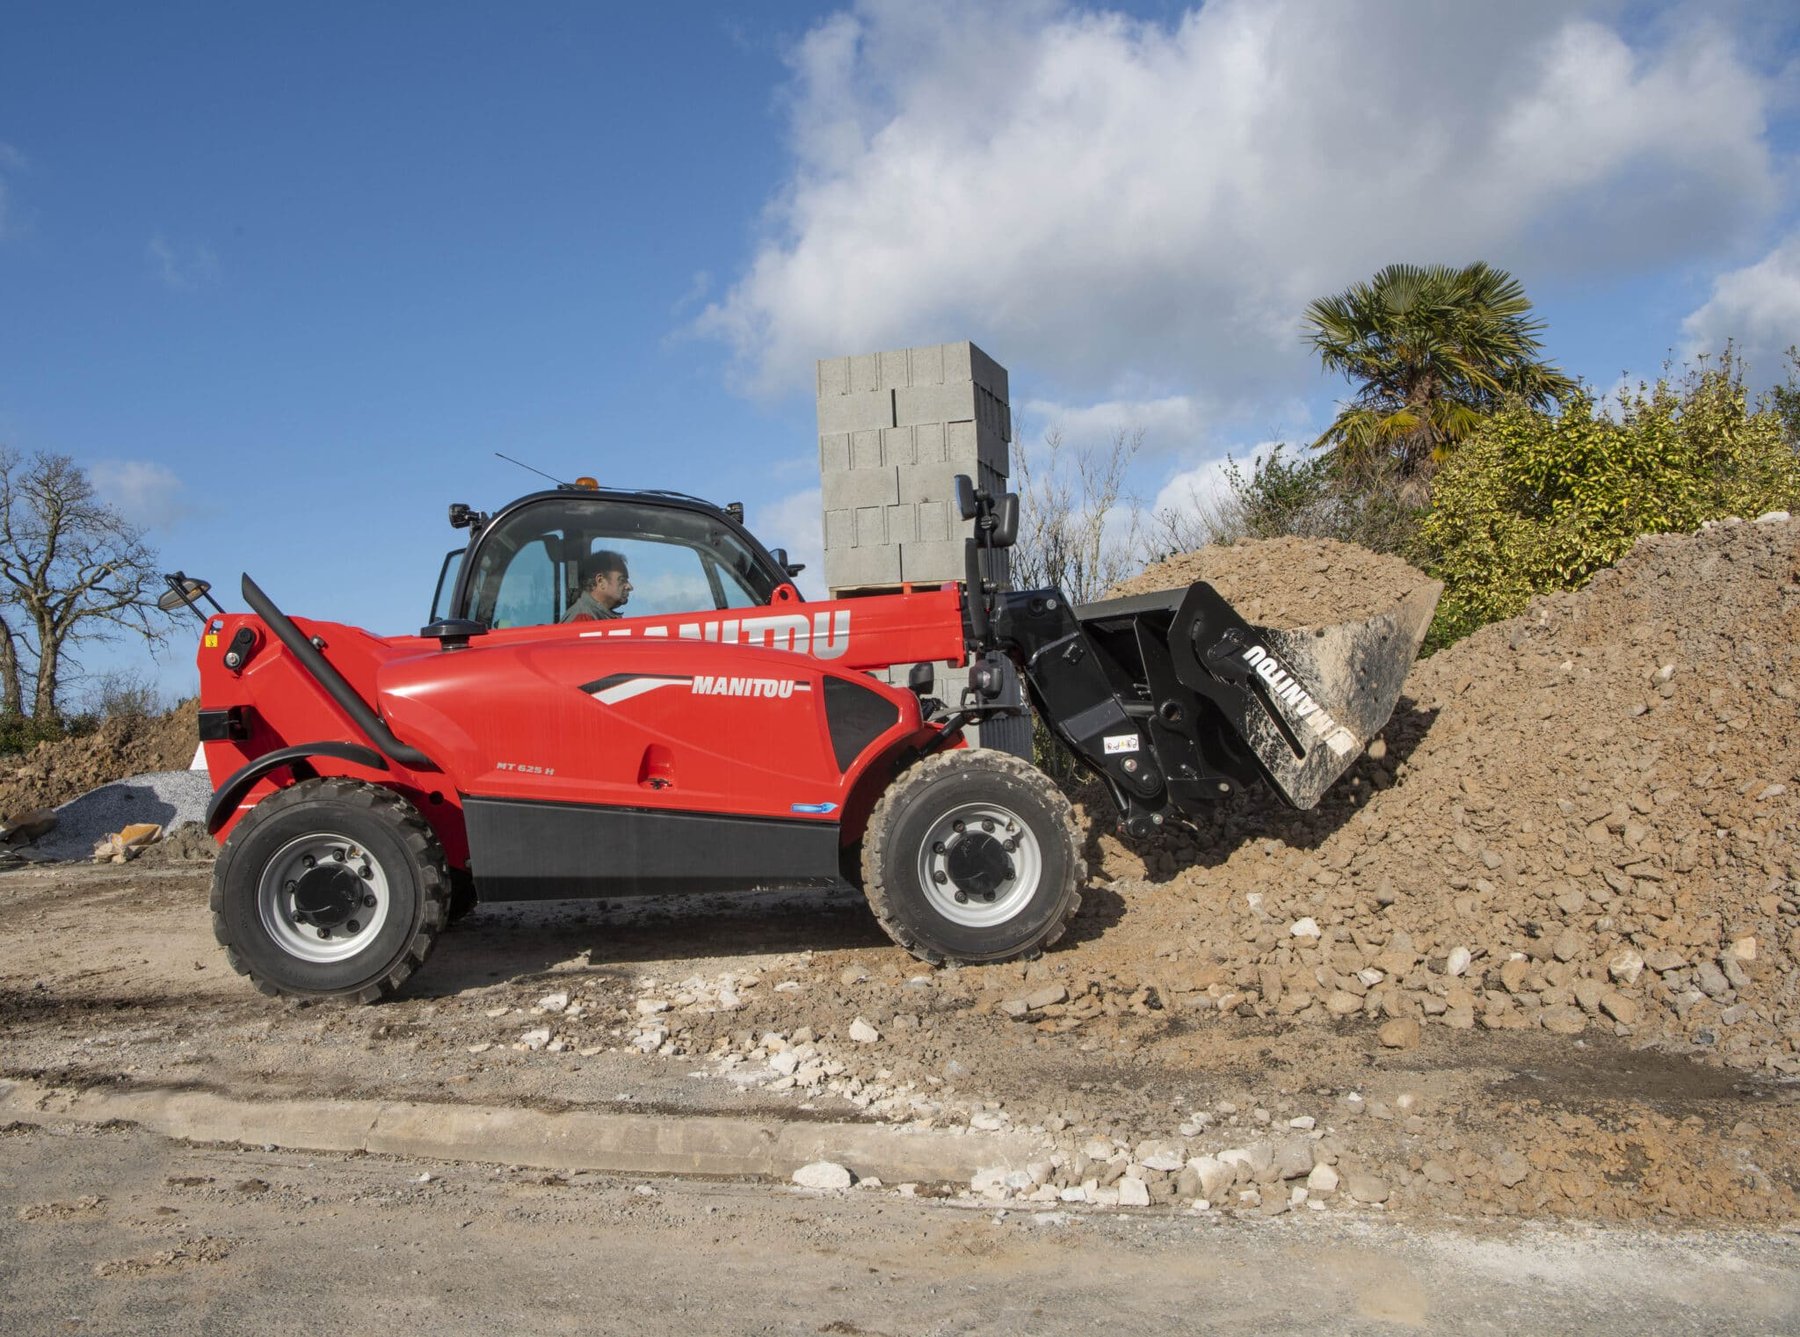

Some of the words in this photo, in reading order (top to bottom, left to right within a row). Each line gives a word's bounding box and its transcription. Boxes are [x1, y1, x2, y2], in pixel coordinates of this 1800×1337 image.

[691, 675, 795, 698] MANITOU
[1242, 645, 1335, 736] MANITOU
[496, 762, 516, 771] MT
[517, 764, 542, 774] 625
[544, 768, 555, 776] H
